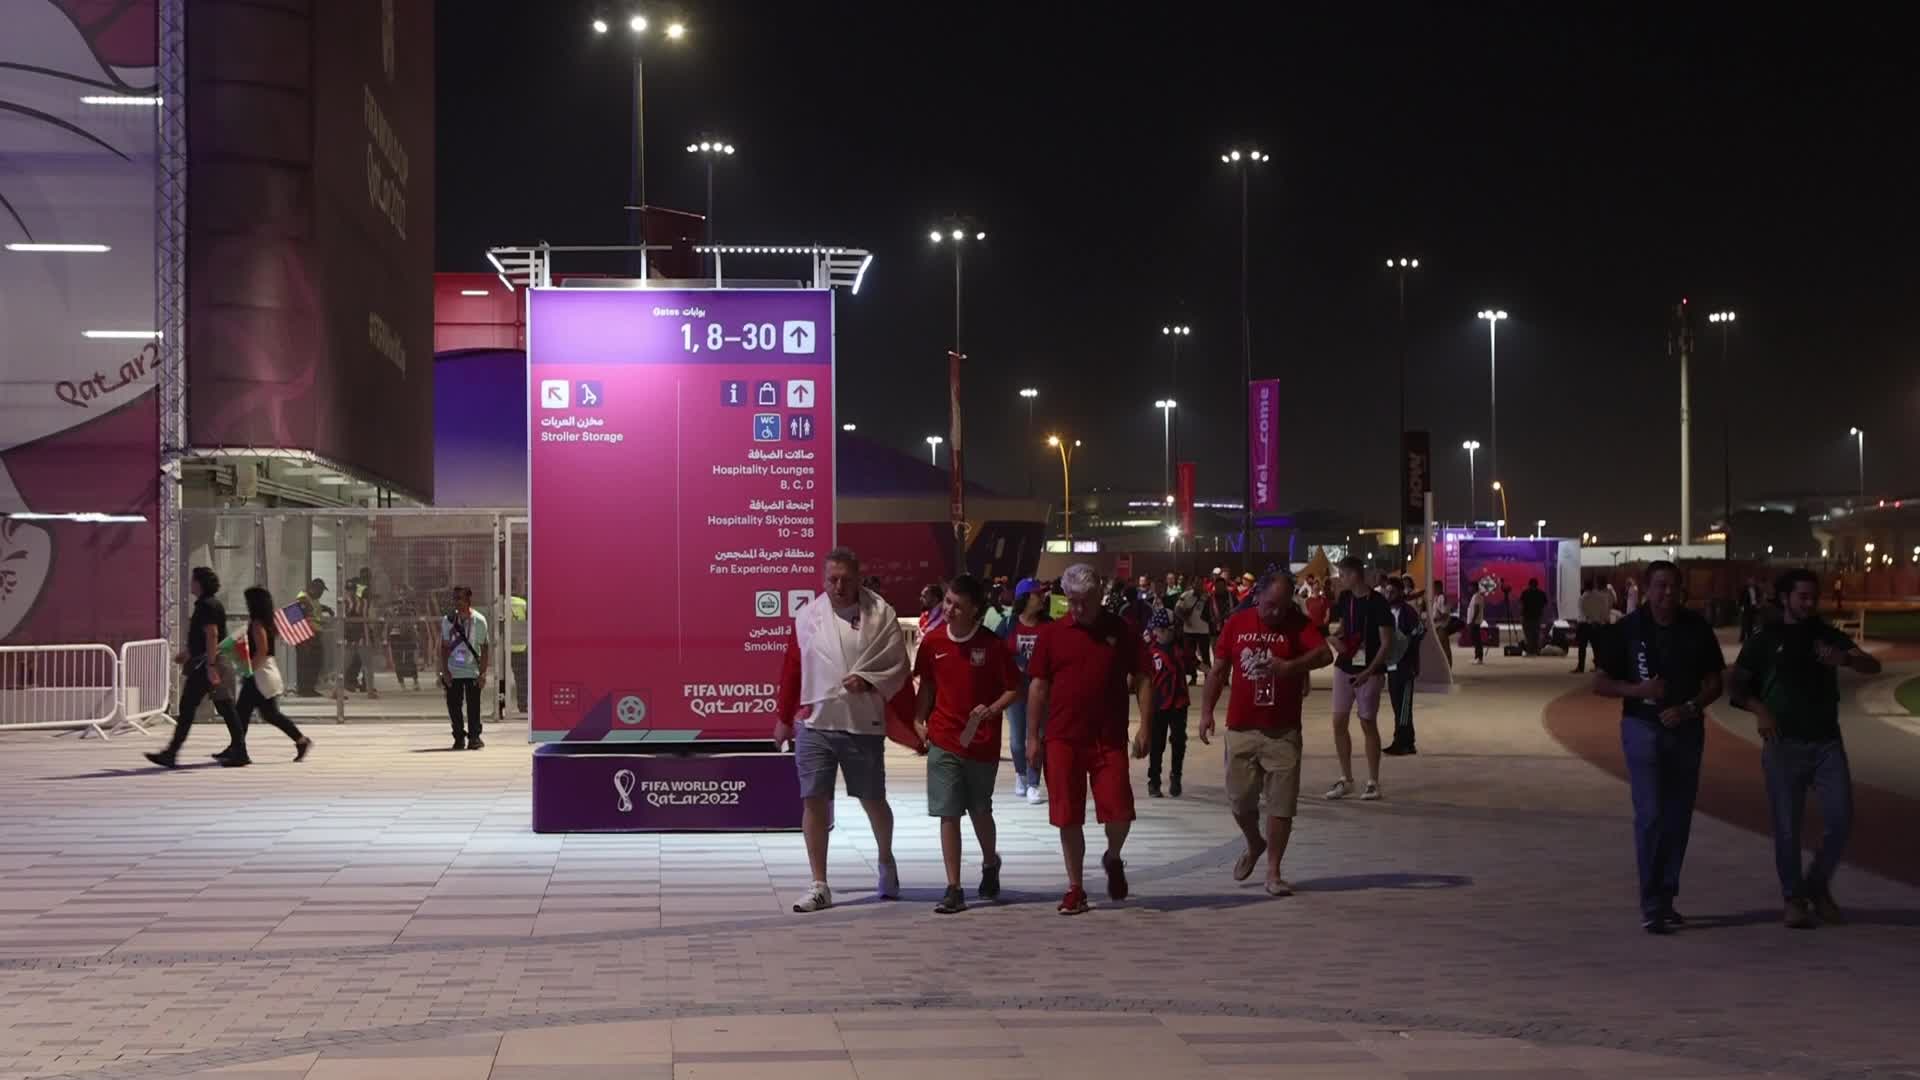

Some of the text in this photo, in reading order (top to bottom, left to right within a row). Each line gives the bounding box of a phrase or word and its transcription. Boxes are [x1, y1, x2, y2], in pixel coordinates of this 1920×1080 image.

[652, 307, 680, 317] Gates
[682, 307, 706, 318] بوابات
[680, 323, 700, 353] 1,
[56, 342, 162, 408] Qatar2
[541, 416, 604, 429] مخزن العربات
[760, 416, 775, 425] WC
[541, 431, 624, 444] Stroller Storage
[748, 449, 815, 461] صالات الضيافة
[712, 464, 815, 477] Hospitality Lounges
[780, 479, 815, 491] B, C, D
[749, 499, 815, 513] أجنحة الضيافة
[707, 515, 815, 527] Hospitality Skyboxes
[777, 528, 791, 538] 10
[800, 528, 815, 538] 38
[714, 548, 815, 561] منطقة تجربة المشجعين
[709, 563, 815, 576] Fan Experience Area
[749, 625, 784, 638] التدخين
[1236, 632, 1286, 644] POLSKA
[683, 684, 718, 697] FIFA
[718, 684, 775, 697] WORLD
[690, 698, 780, 718] Qatar20
[640, 780, 747, 792] FIFA WORLD CUP
